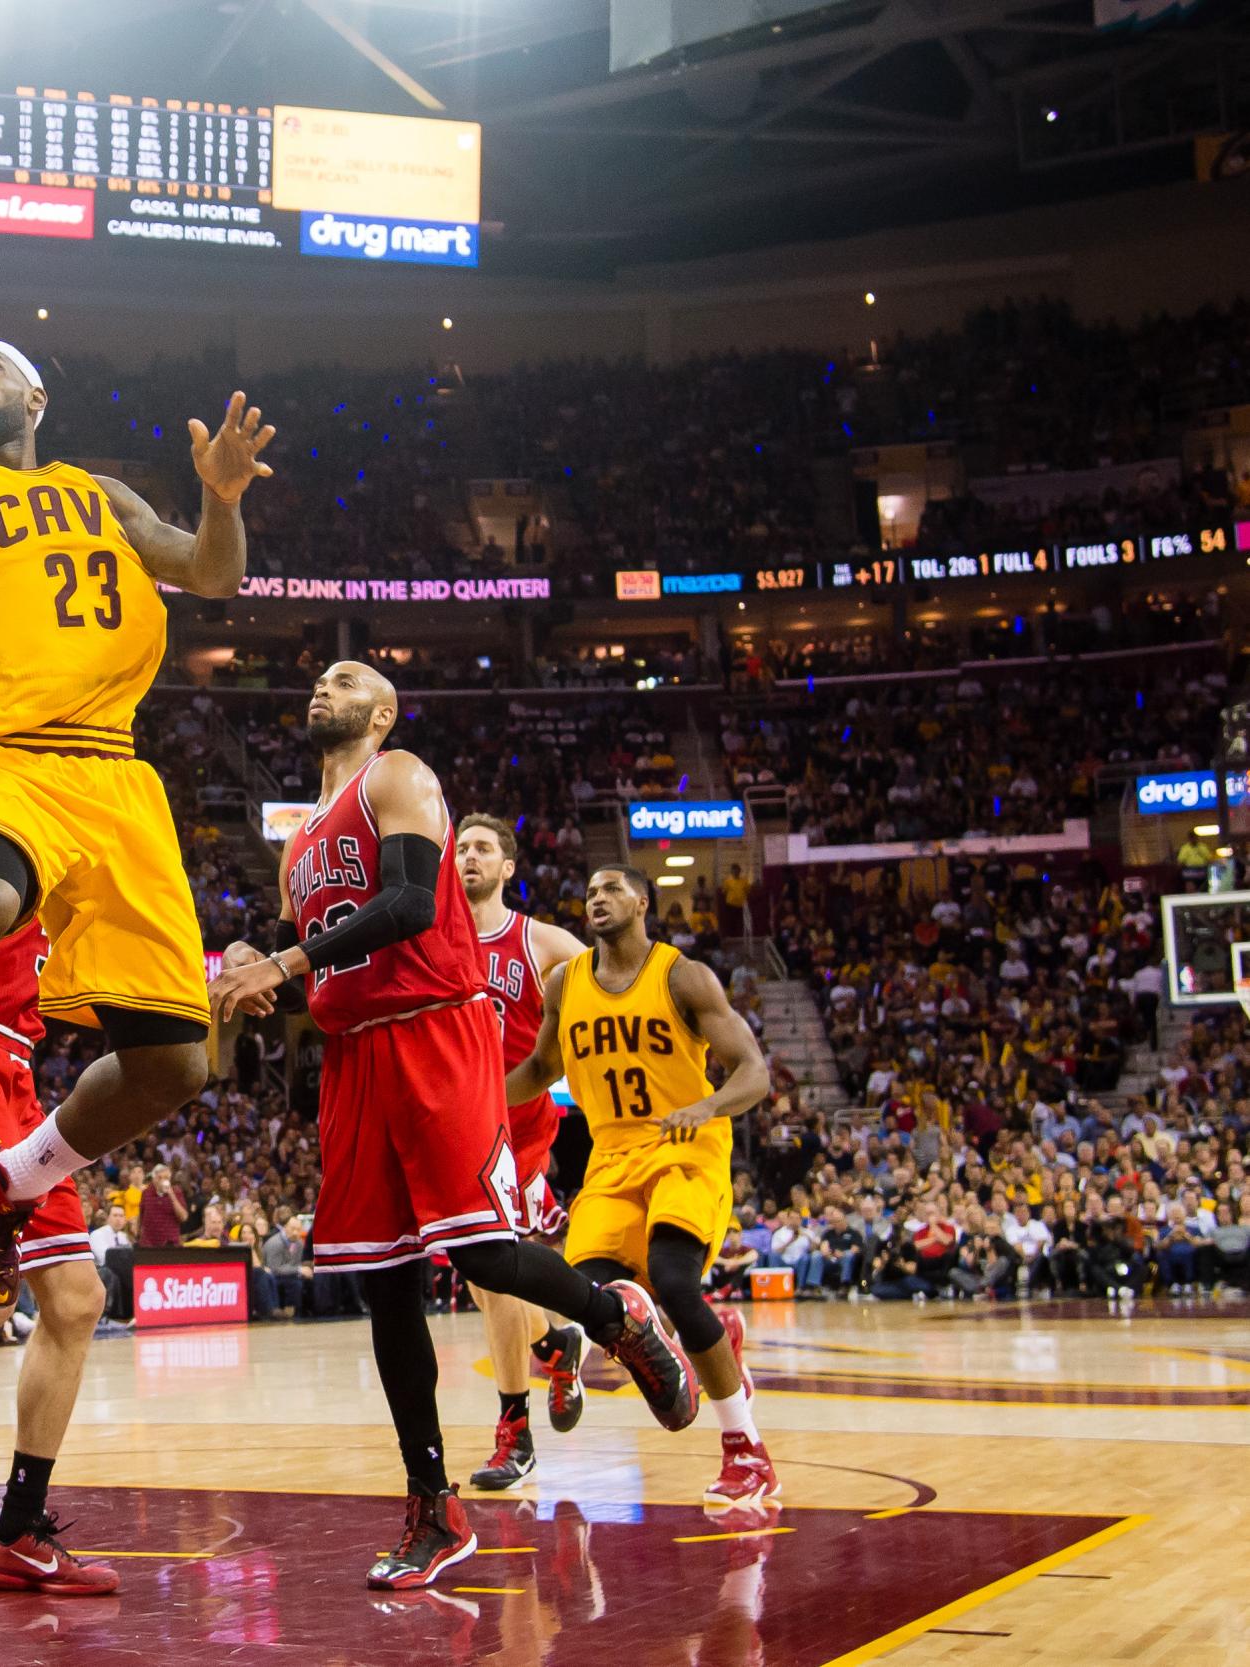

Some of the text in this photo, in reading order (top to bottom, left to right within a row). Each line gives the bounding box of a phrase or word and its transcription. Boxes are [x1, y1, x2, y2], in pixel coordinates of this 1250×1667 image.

[130, 198, 261, 223] GASOL IN FOR THE
[107, 219, 184, 240] CAVALIERS
[184, 222, 227, 243] KYRIE
[309, 213, 471, 258] drug mart
[911, 558, 946, 580] TOL:
[978, 553, 990, 576] 1
[993, 552, 1034, 573] FULL
[1034, 549, 1048, 571] 4
[1066, 543, 1118, 568] FOULS
[1121, 540, 1135, 563] 3
[1151, 534, 1193, 558] FG%
[1200, 527, 1227, 553] 54
[662, 573, 743, 594] mazda
[855, 560, 895, 585] +17
[44, 550, 122, 630] 23
[237, 576, 550, 600] CAVS DUNK IN THE 3RD QUARTER!
[1139, 779, 1199, 807] drug
[631, 806, 743, 835] drug mart
[569, 1015, 675, 1061] CAVS
[603, 1067, 653, 1119] 13
